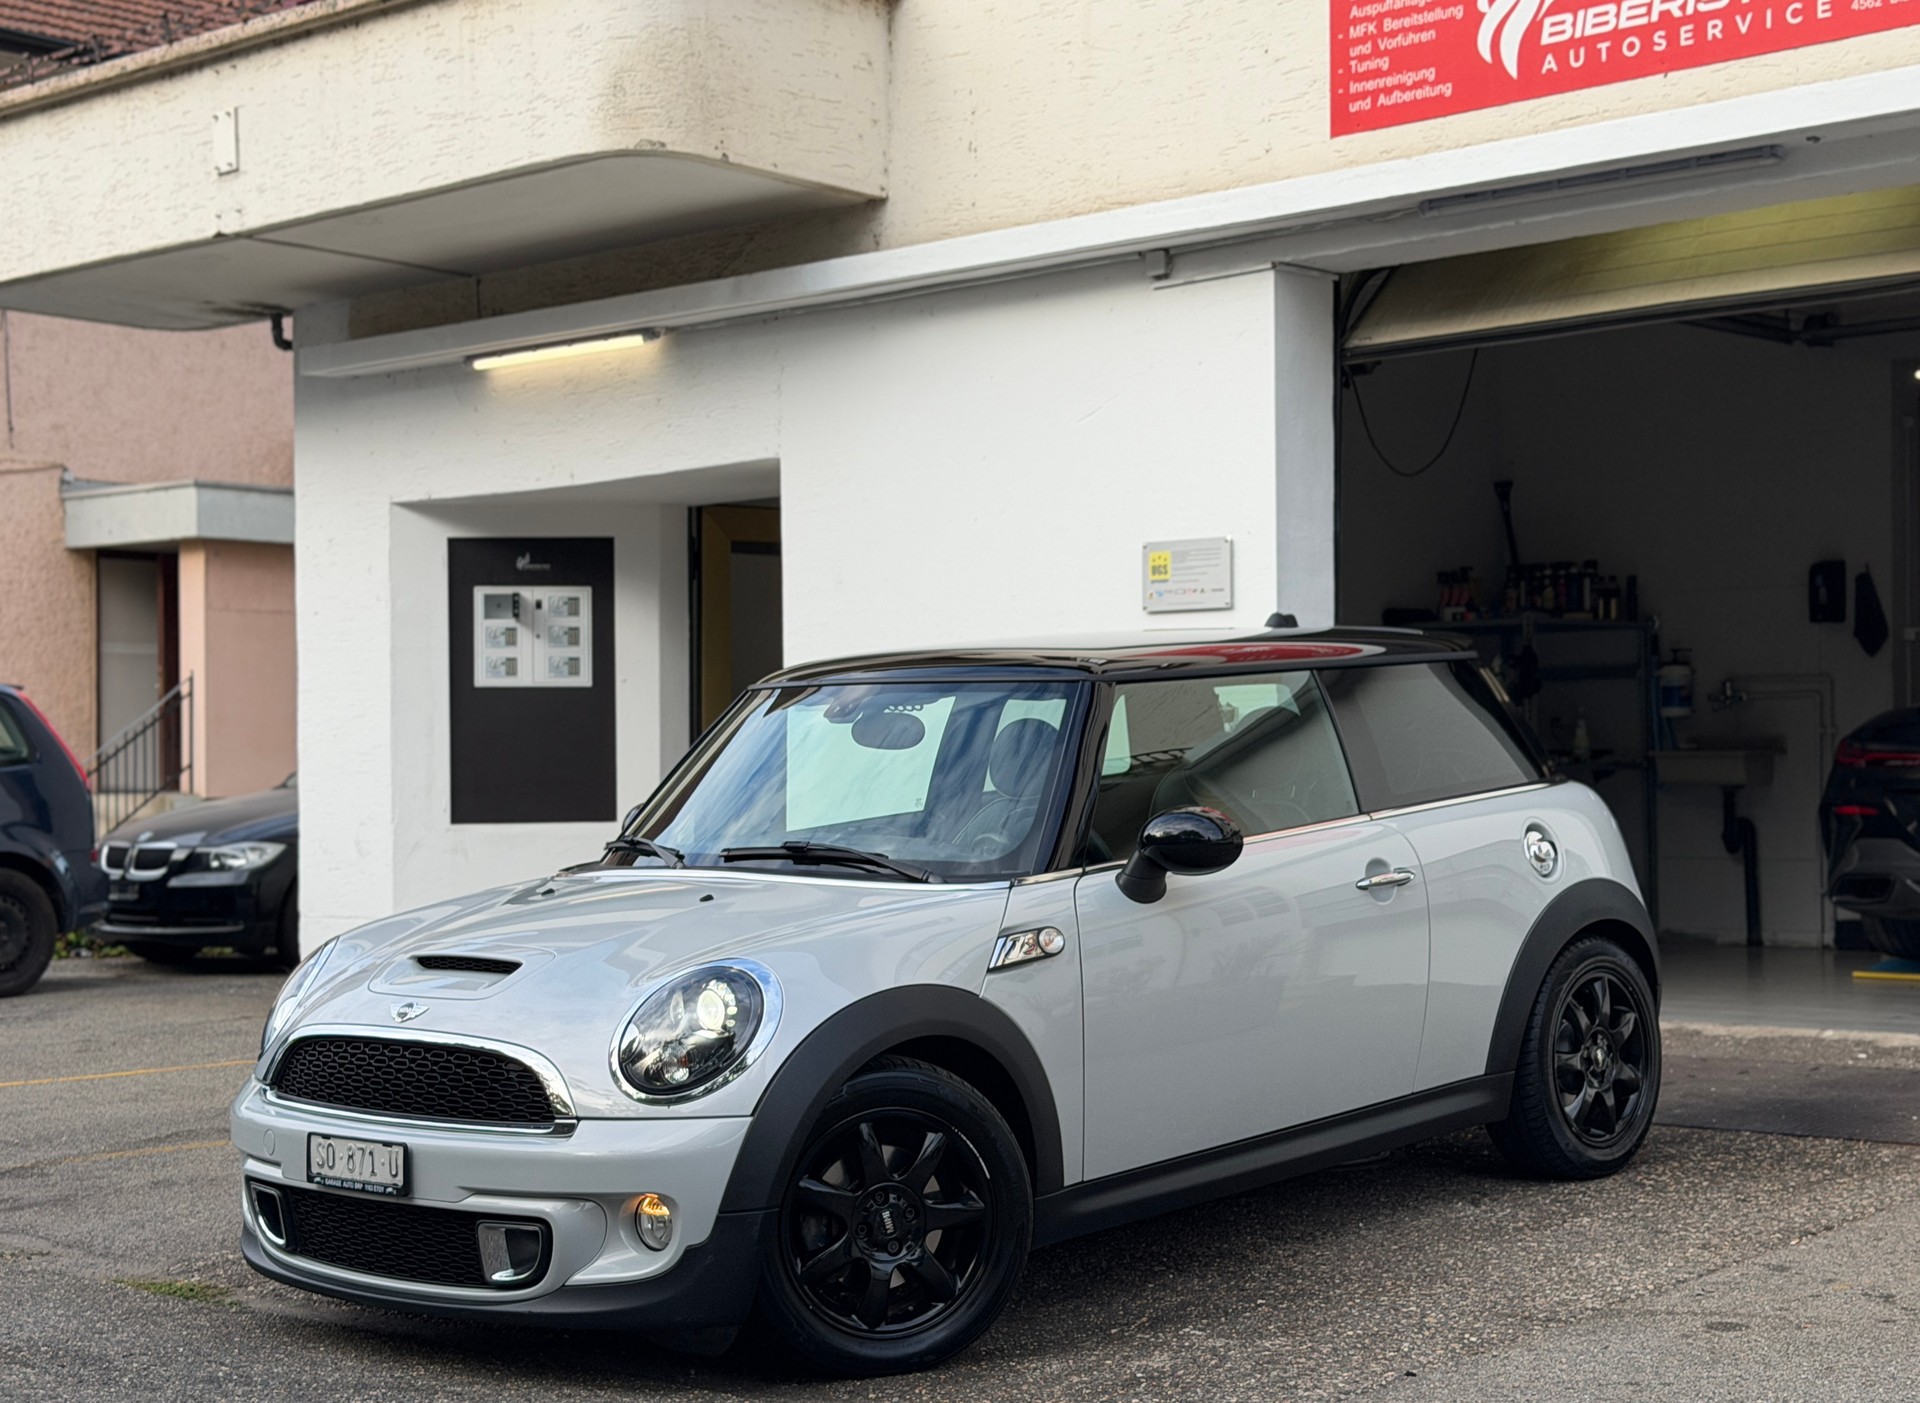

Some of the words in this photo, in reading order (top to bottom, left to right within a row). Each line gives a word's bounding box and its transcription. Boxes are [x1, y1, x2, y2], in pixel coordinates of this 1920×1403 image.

[1349, 21, 1377, 39] MFK
[1383, 5, 1464, 32] Bereitstellung
[1349, 40, 1372, 57] und
[1377, 29, 1436, 51] Vorführen
[1541, 0, 1832, 75] AUTOSERVICE
[1349, 56, 1389, 74] Tuning
[1349, 67, 1436, 94] Innenreinigung
[1348, 96, 1371, 113] und
[1377, 82, 1453, 107] Aufbereitung
[346, 1143, 377, 1176] 871
[388, 1147, 399, 1178] U
[325, 1178, 341, 1187] GARAGE
[343, 1181, 353, 1189] AUTO
